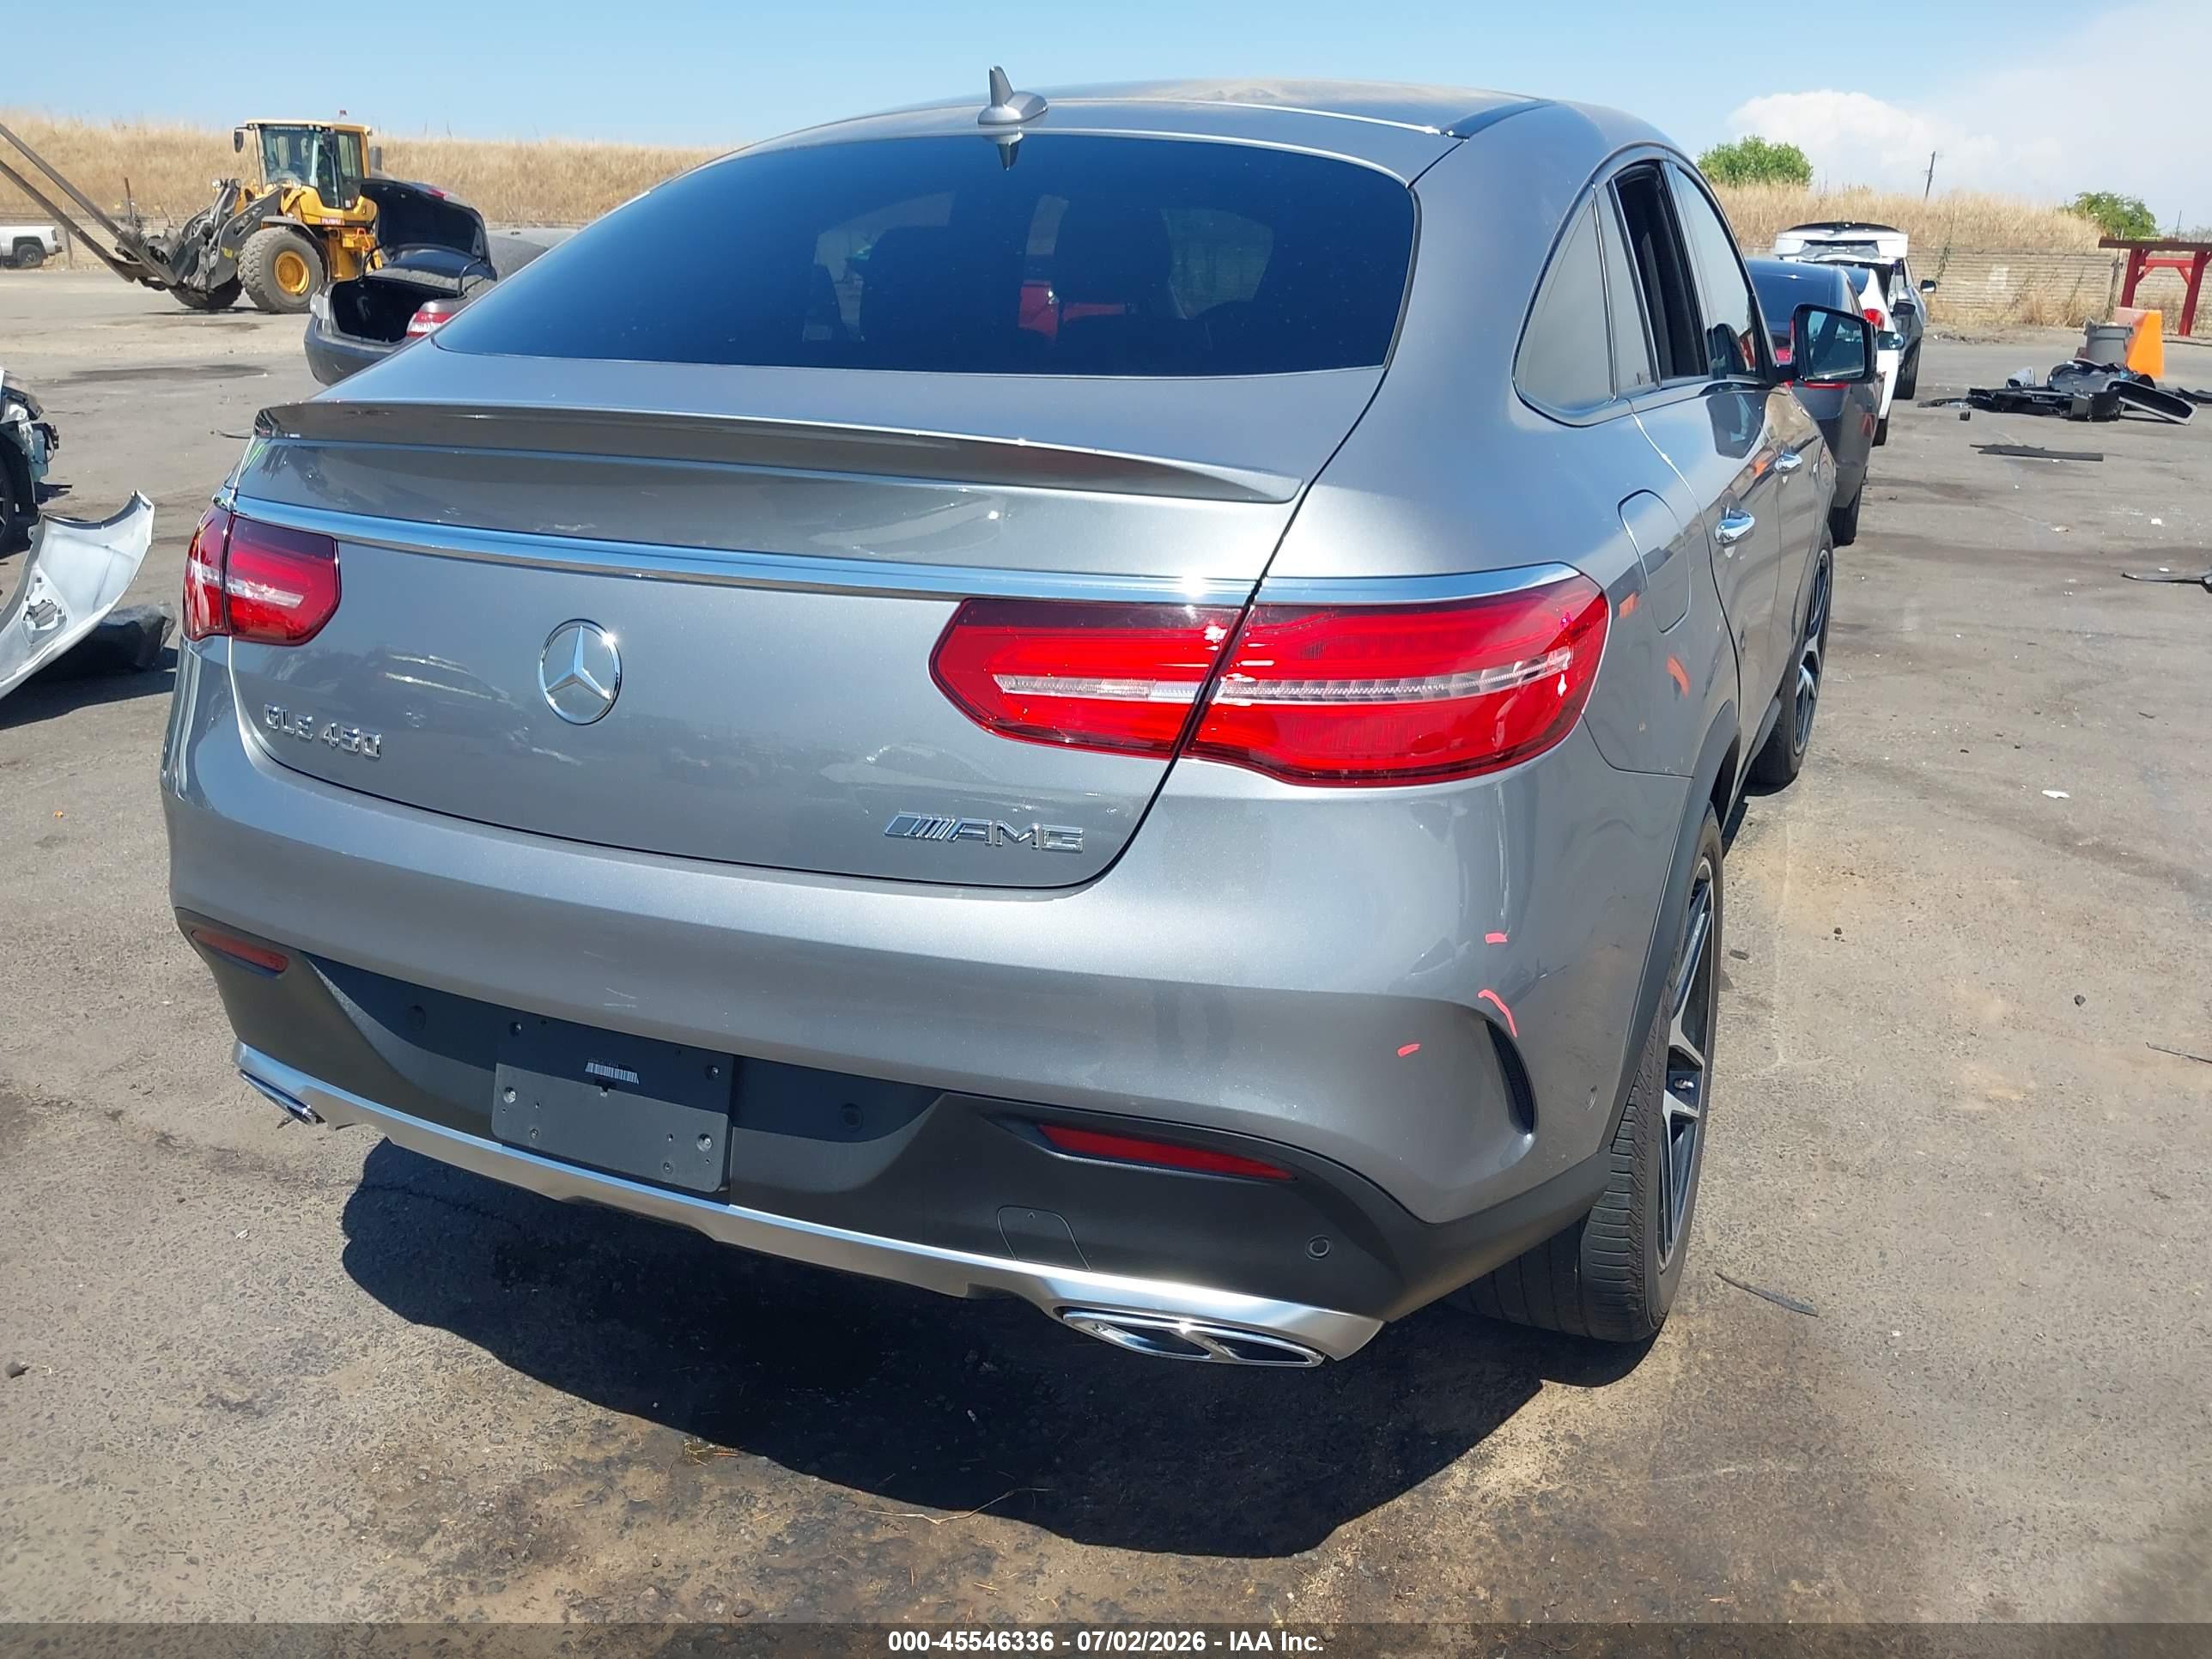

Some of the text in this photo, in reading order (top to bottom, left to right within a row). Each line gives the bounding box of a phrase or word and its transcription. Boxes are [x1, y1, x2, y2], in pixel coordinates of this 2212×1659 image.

[264, 703, 382, 758] GLE 450
[947, 817, 1085, 853] AMG
